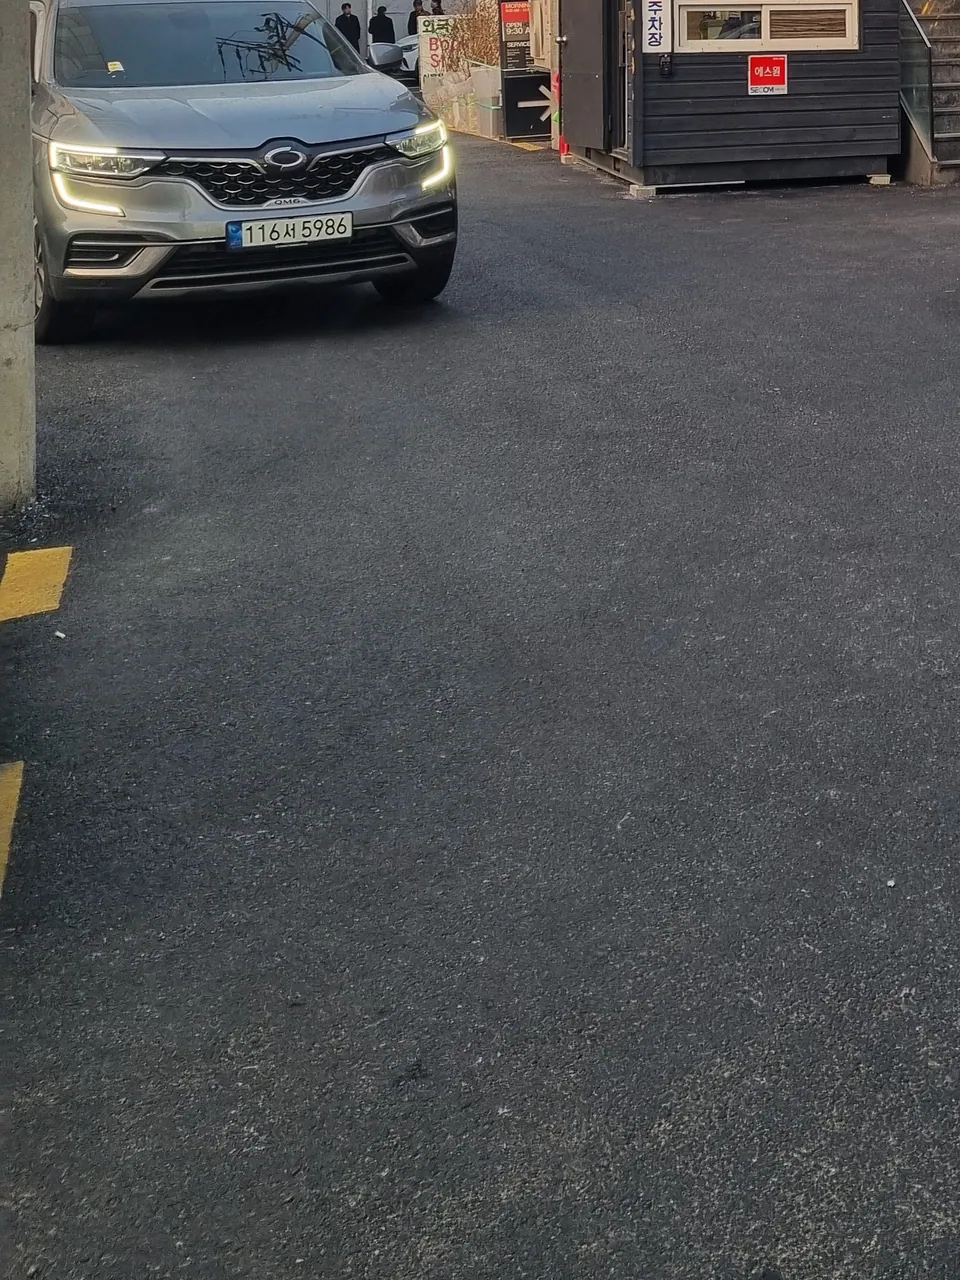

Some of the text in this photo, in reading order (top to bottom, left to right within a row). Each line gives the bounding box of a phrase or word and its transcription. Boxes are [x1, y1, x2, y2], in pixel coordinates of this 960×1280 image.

[506, 27, 523, 36] 9:30
[754, 65, 781, 78] 에스원
[750, 86, 775, 94] SECOM
